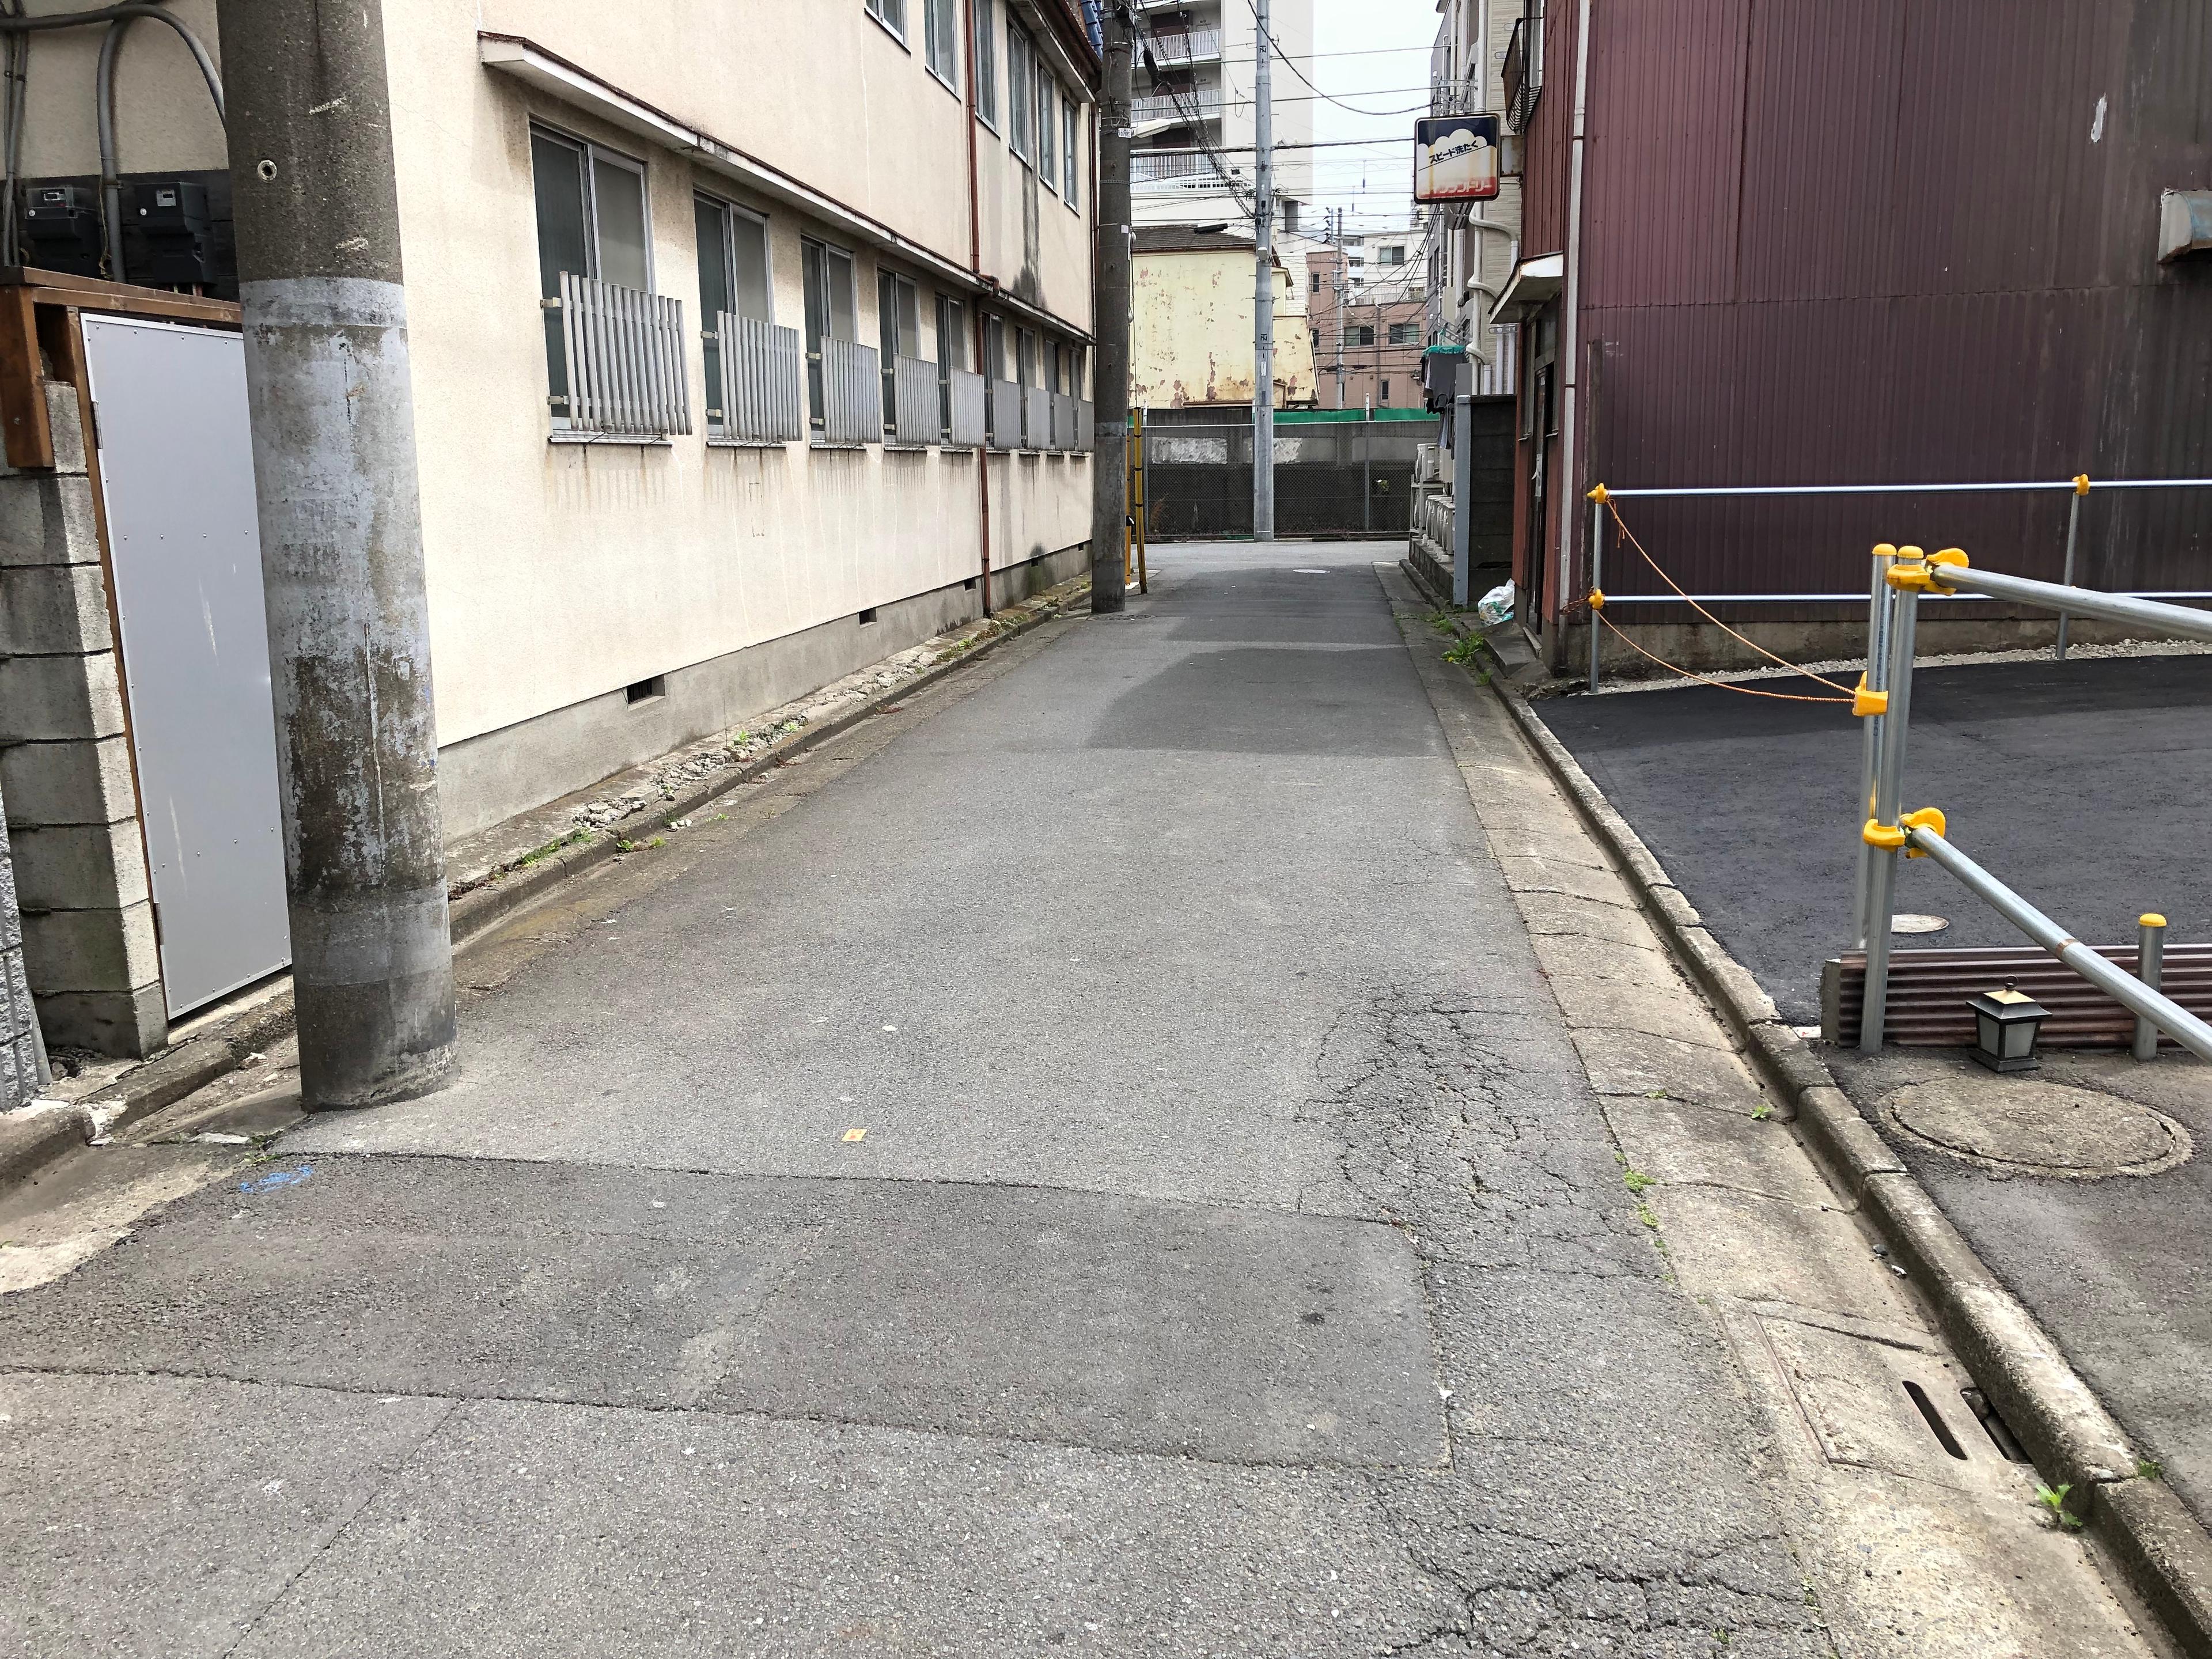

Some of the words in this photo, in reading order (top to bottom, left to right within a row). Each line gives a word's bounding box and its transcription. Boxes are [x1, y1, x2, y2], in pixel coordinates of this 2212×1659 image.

[1429, 140, 1479, 164] スピード洗たく
